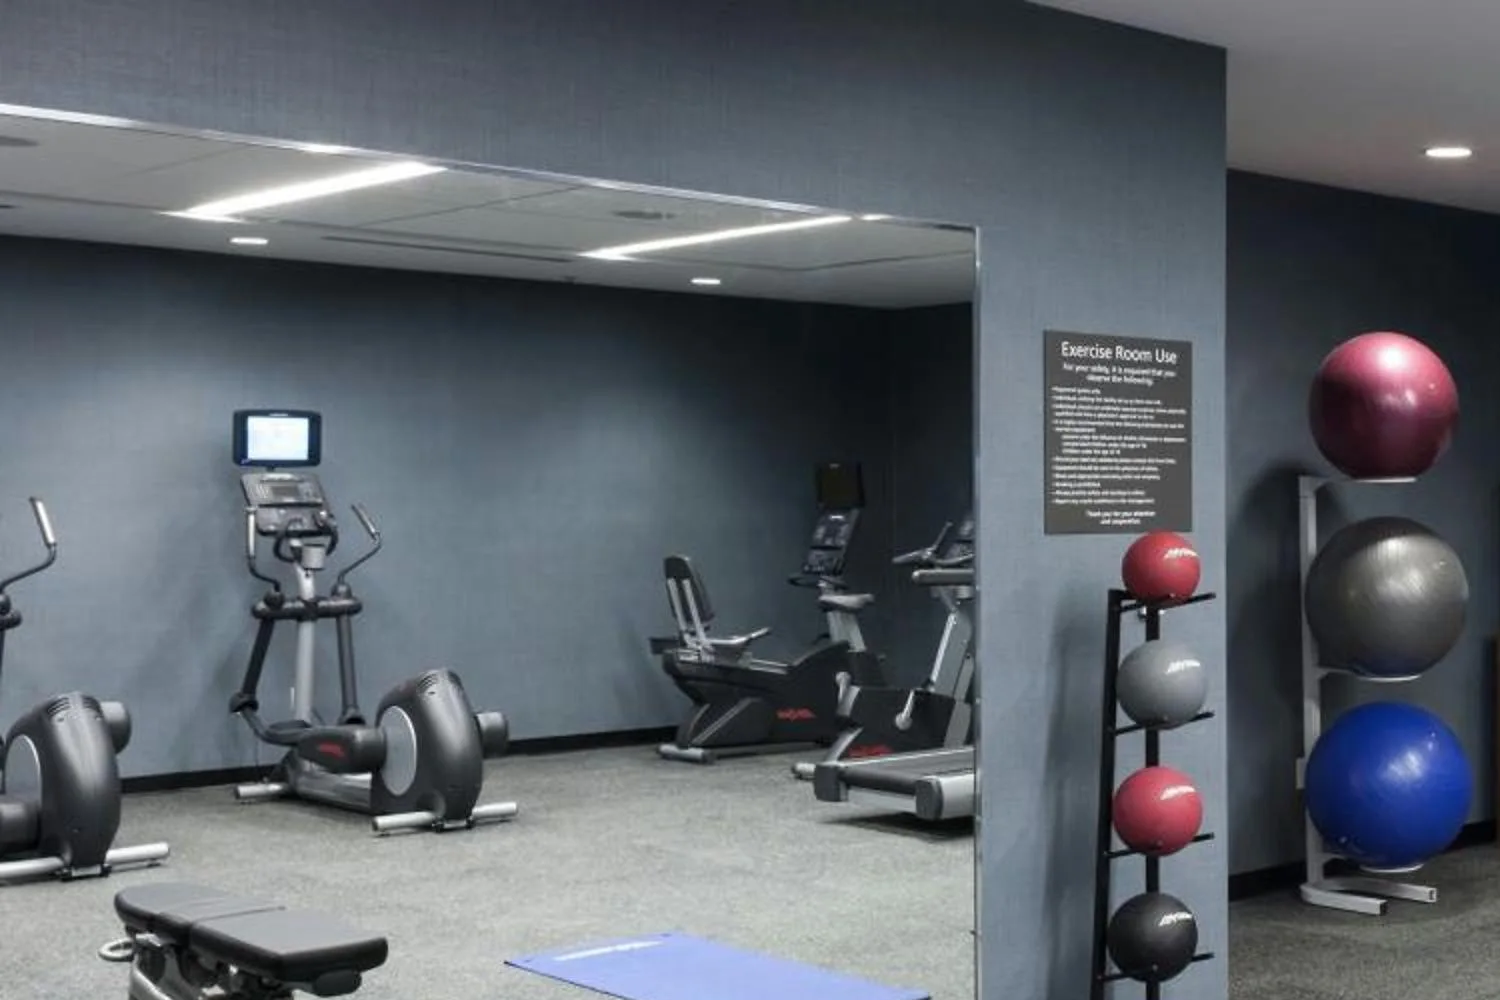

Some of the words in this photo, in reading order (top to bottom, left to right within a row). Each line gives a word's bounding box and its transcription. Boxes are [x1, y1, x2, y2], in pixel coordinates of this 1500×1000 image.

[1061, 341, 1113, 359] Exercise
[1115, 345, 1152, 361] Room
[1155, 348, 1177, 365] Use
